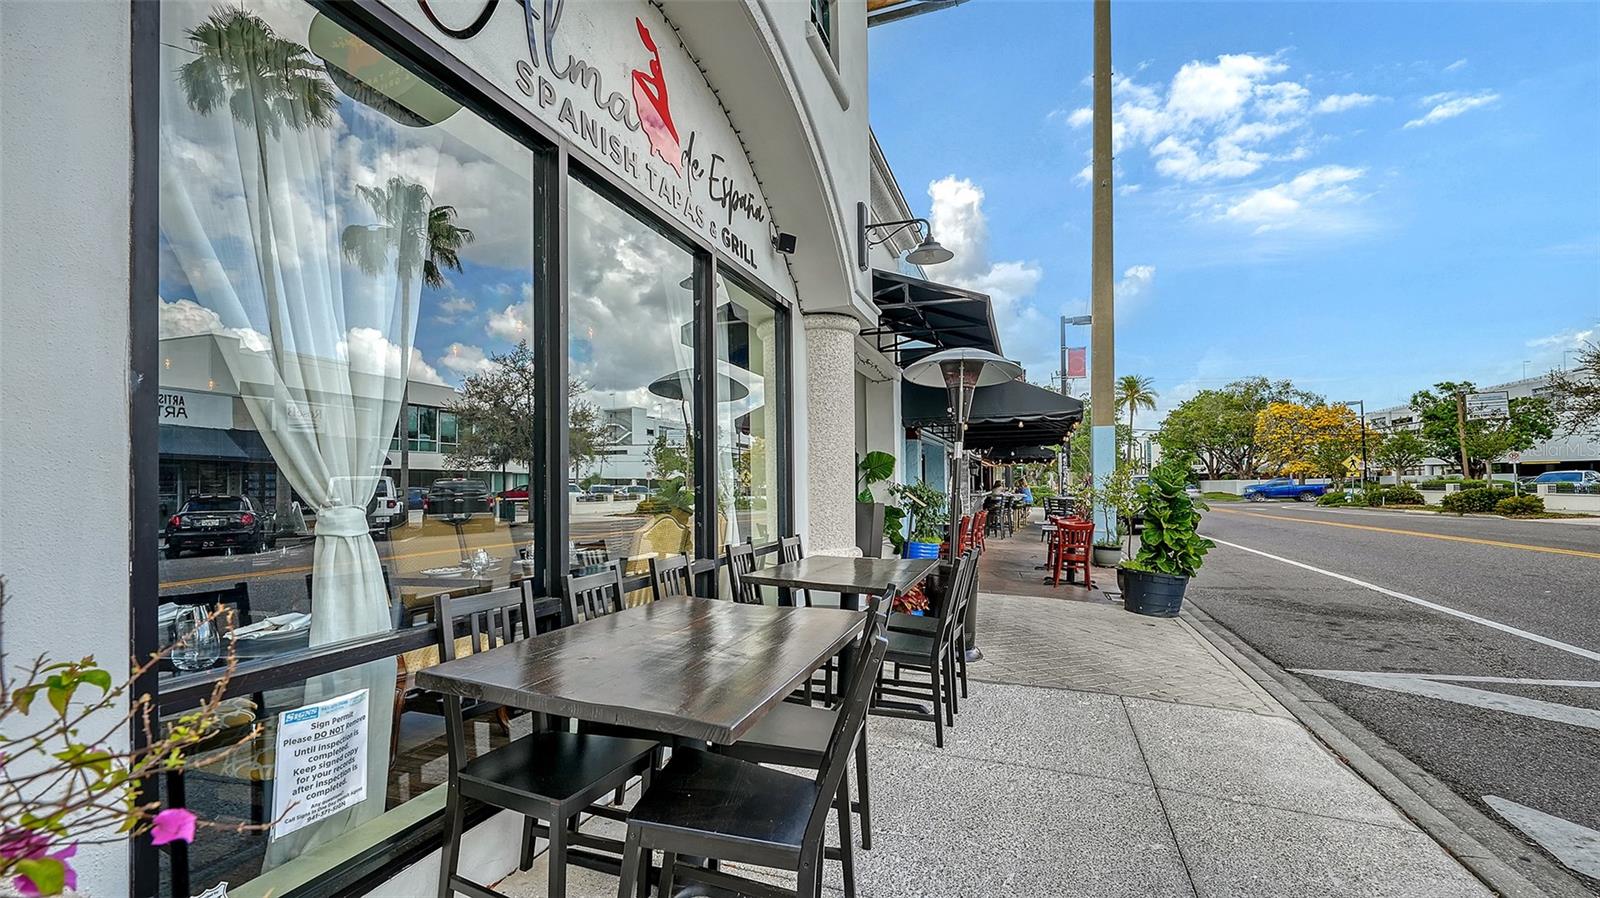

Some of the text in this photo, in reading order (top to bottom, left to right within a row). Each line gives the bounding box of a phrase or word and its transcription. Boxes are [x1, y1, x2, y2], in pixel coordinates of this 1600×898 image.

[515, 59, 758, 270] SPANISH TAPAS & GRILL
[680, 131, 705, 197] de
[708, 153, 765, 226] España
[283, 715, 366, 747] Please DO NOT Remove
[311, 711, 354, 730] Sign Permit
[294, 745, 316, 758] Until
[318, 732, 354, 751] inspection
[293, 746, 359, 777] Keep signed copy
[296, 756, 356, 785] for your records
[292, 783, 314, 796] after
[315, 767, 351, 788] inspection
